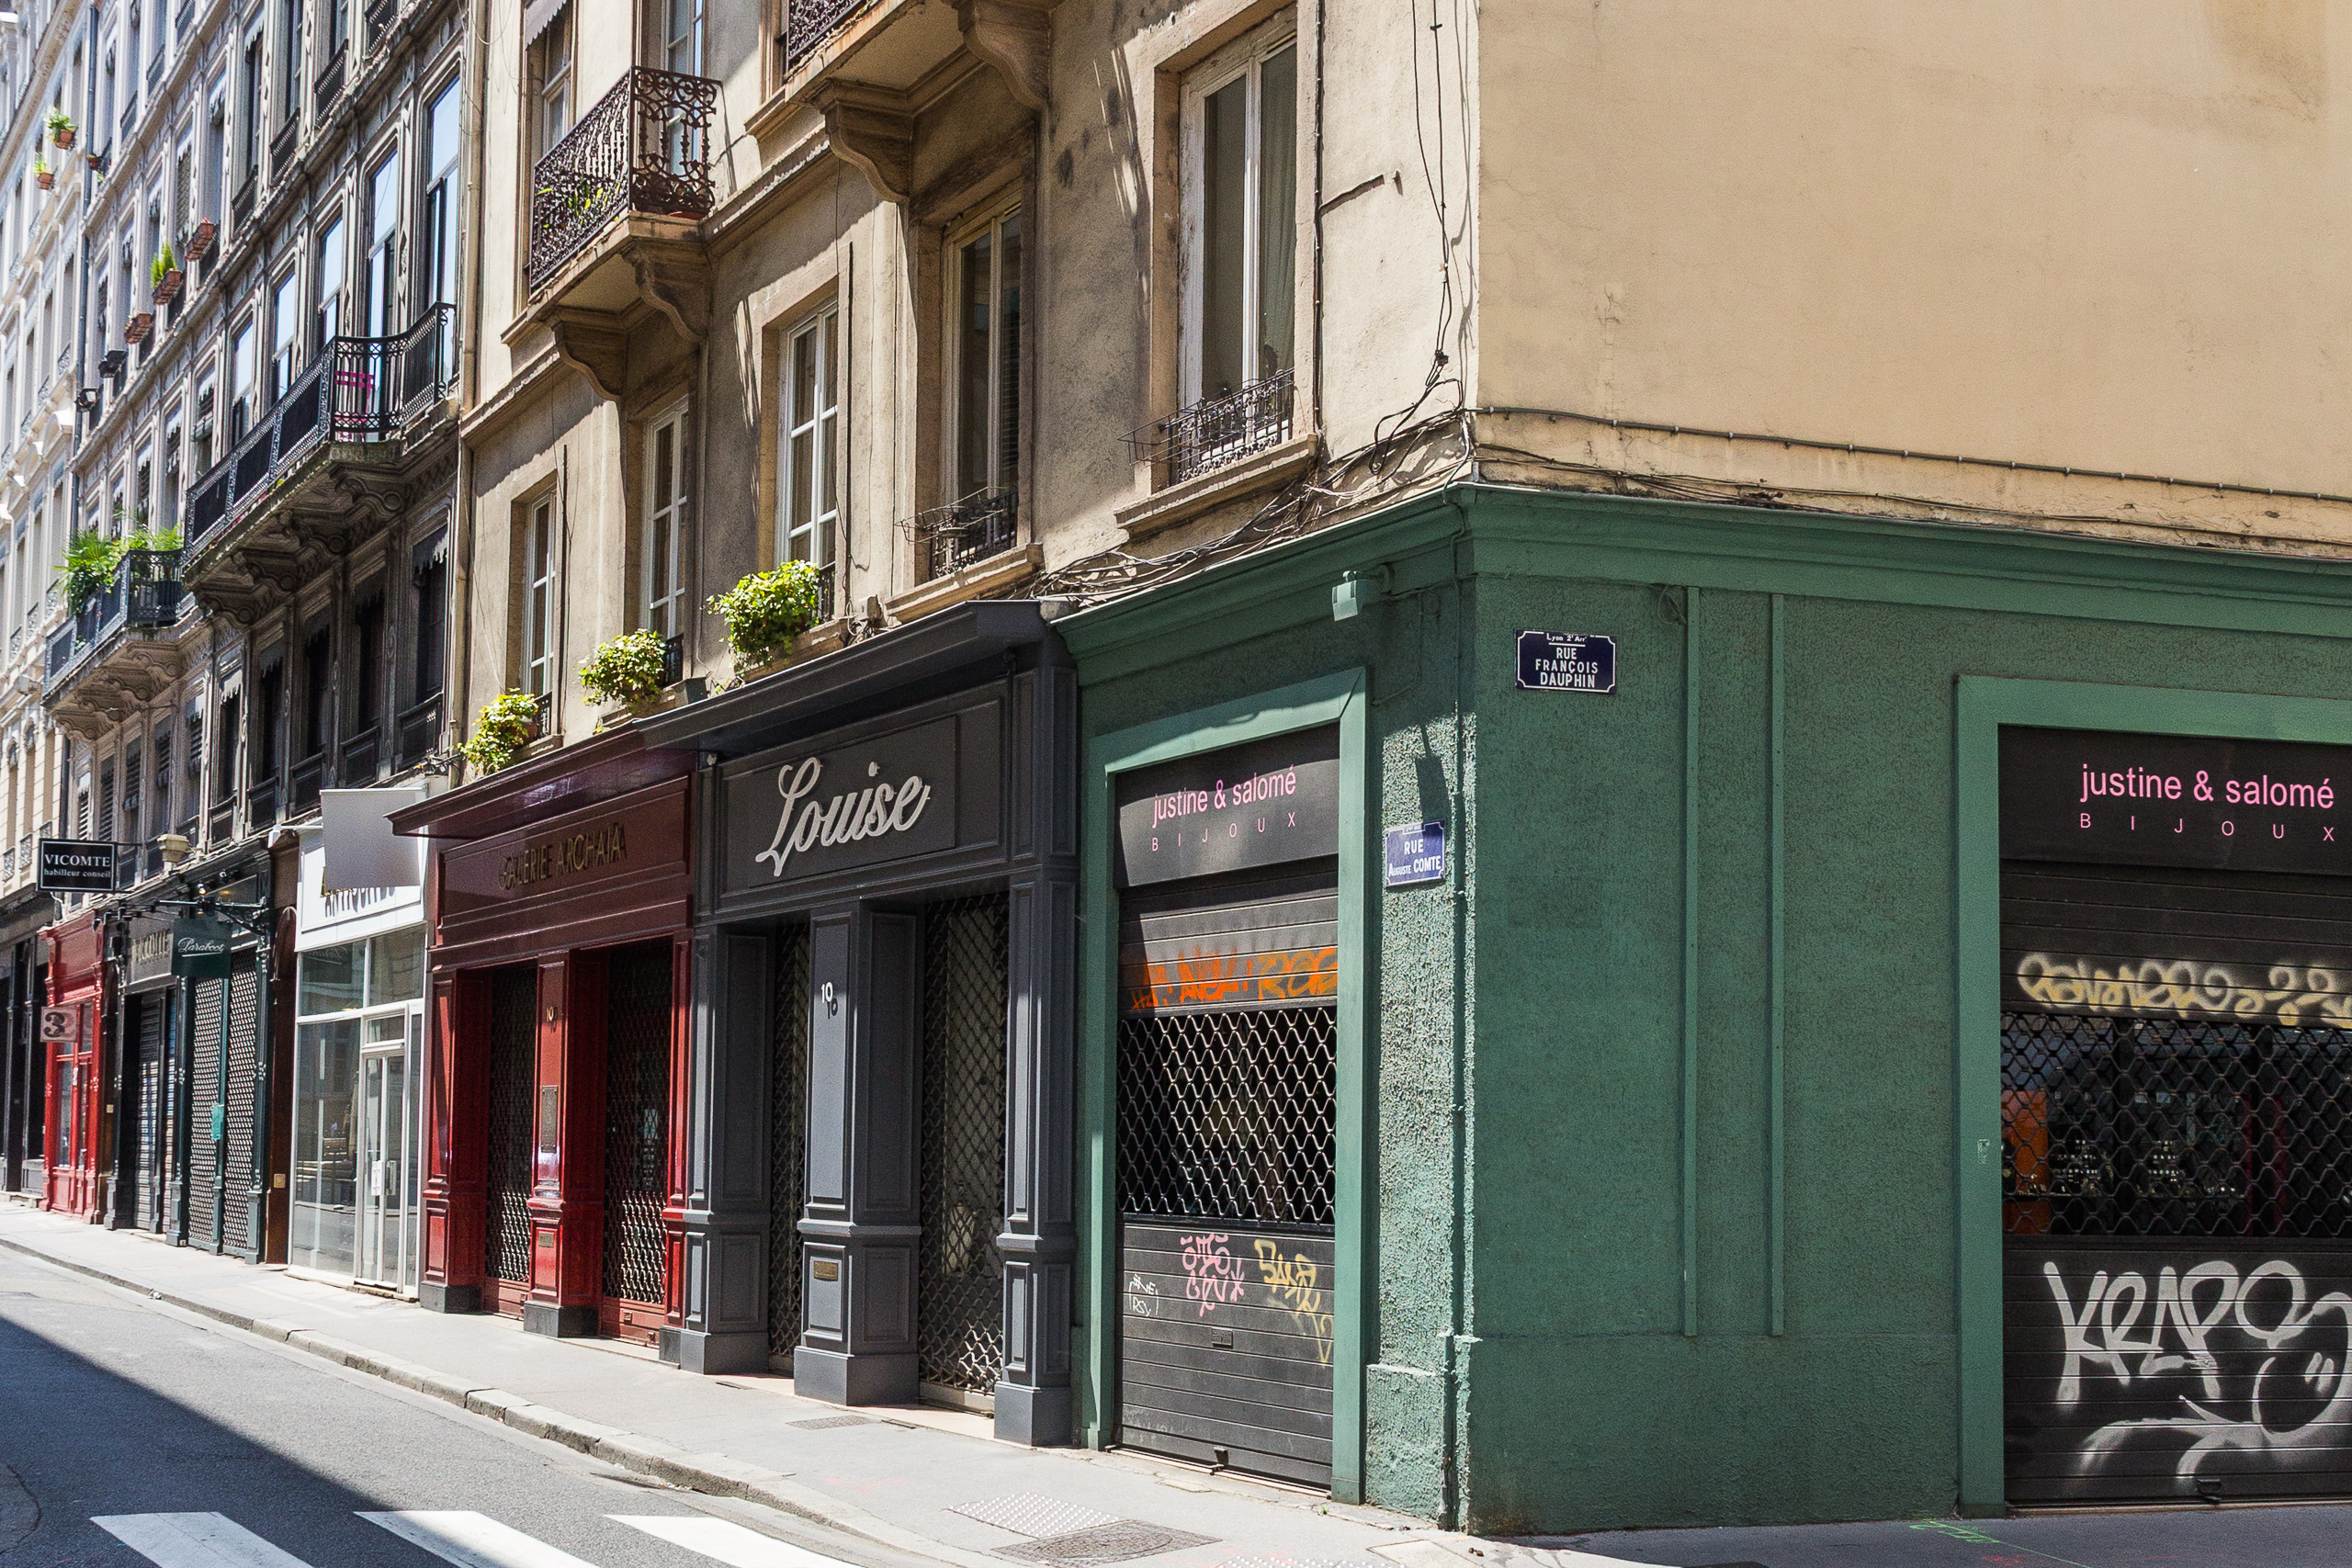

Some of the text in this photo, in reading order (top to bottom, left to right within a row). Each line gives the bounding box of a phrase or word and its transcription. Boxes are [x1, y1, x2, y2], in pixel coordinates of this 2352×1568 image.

[1555, 647, 1577, 660] RUE
[1535, 659, 1599, 673] FRANÇOIS
[1540, 672, 1596, 688] DAUPHIN
[2079, 763, 2335, 809] justine & salomé
[1152, 764, 1296, 829] justine & salomé
[755, 757, 931, 876] Louise
[1151, 811, 1295, 852] BIJOUX
[2079, 813, 2335, 841] BIJOUX
[1404, 839, 1424, 855] RUE
[44, 853, 111, 867] VICOMTE
[1413, 855, 1442, 874] COMTE
[44, 867, 111, 878] habilleur conseil
[177, 937, 225, 953] Paraboot
[820, 981, 833, 1003] 10
[43, 1011, 65, 1037] 3
